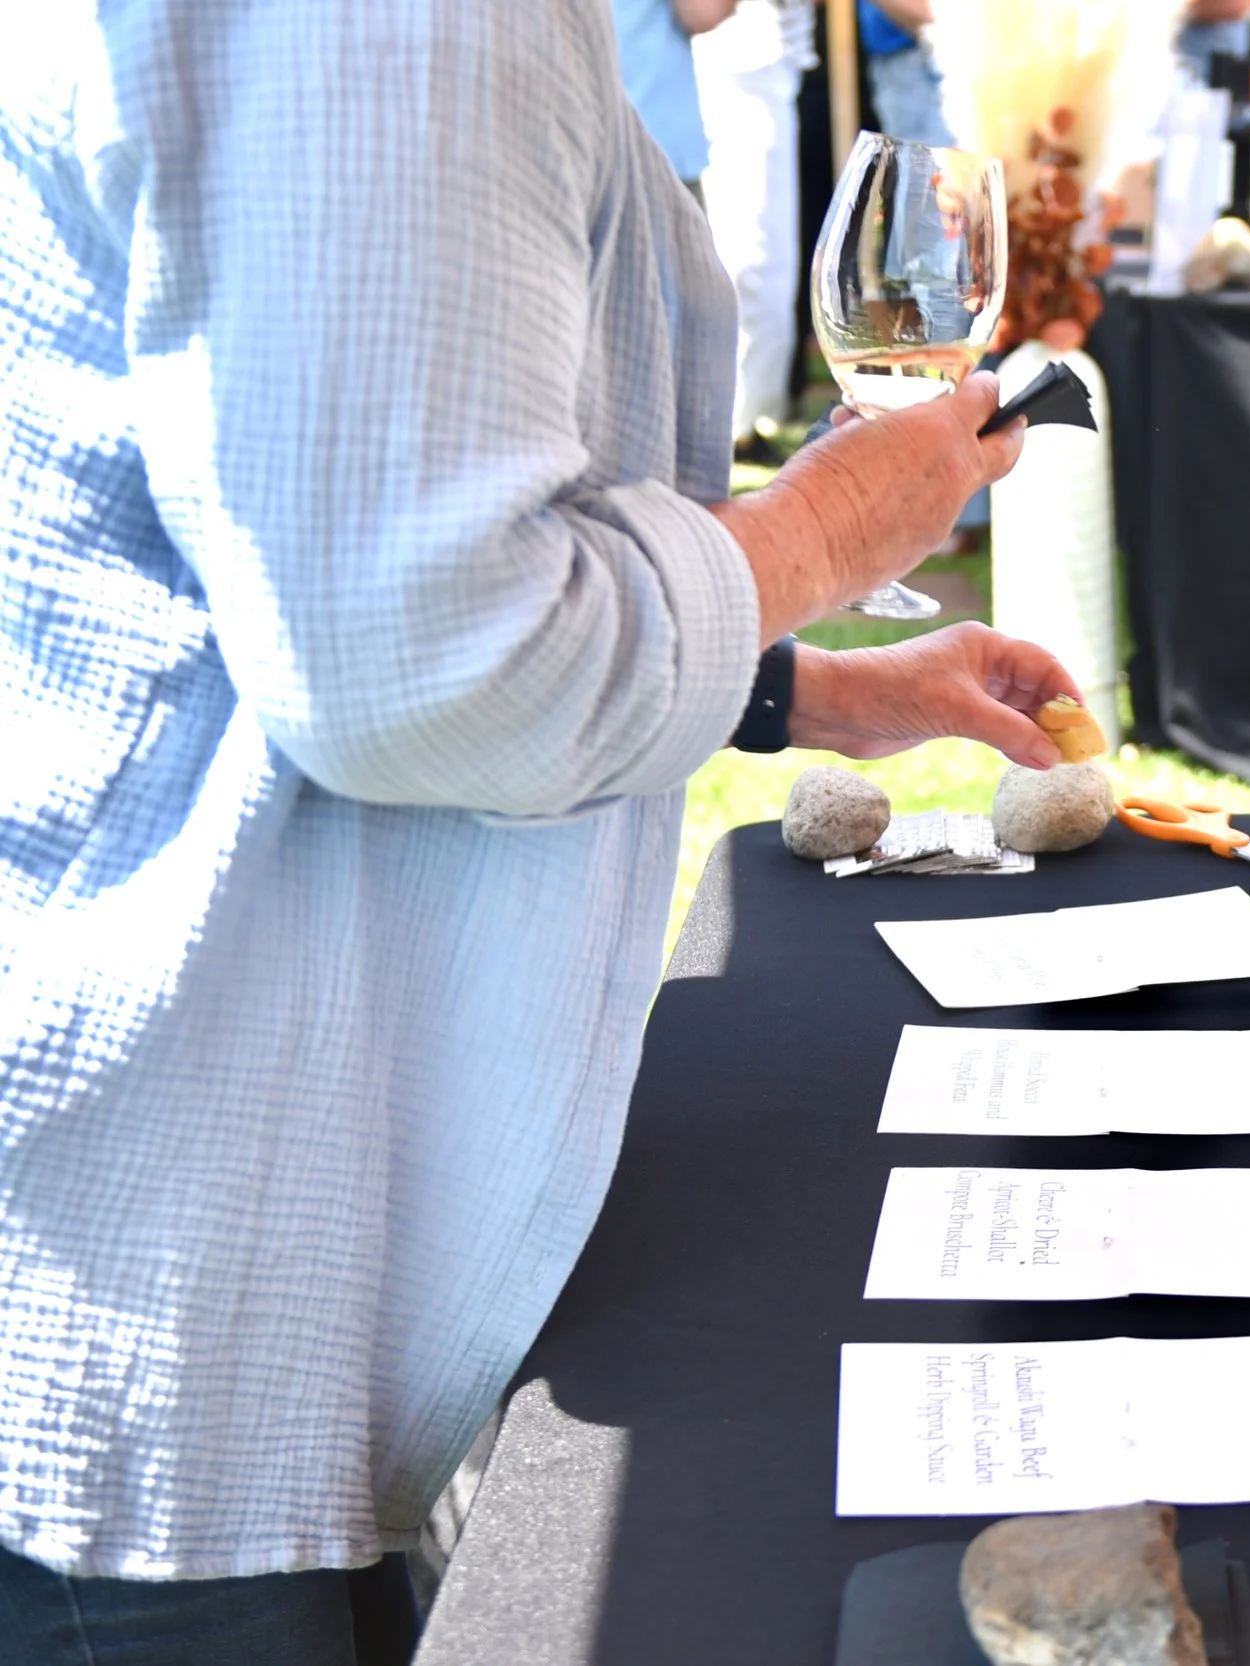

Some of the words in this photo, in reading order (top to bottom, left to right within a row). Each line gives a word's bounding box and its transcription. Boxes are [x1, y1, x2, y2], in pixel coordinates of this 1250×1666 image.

[952, 1083, 976, 1102] Feta
[989, 1061, 1014, 1098] Hummus
[986, 1101, 1011, 1119] and
[945, 1170, 981, 1211] Compote
[988, 1182, 1022, 1263] Apricot-Shallot
[1036, 1215, 1061, 1225] &
[941, 1213, 974, 1278] Bruschetta
[1033, 1229, 1060, 1266] Dried
[926, 1356, 954, 1388] Herb
[961, 1353, 1000, 1411] Springroll
[1014, 1356, 1045, 1402] Akaushi
[917, 1391, 952, 1441] Dipping
[973, 1414, 998, 1426] &
[927, 1444, 954, 1484] Sauce
[973, 1430, 1004, 1485] Garden
[1012, 1446, 1054, 1479] Beef
